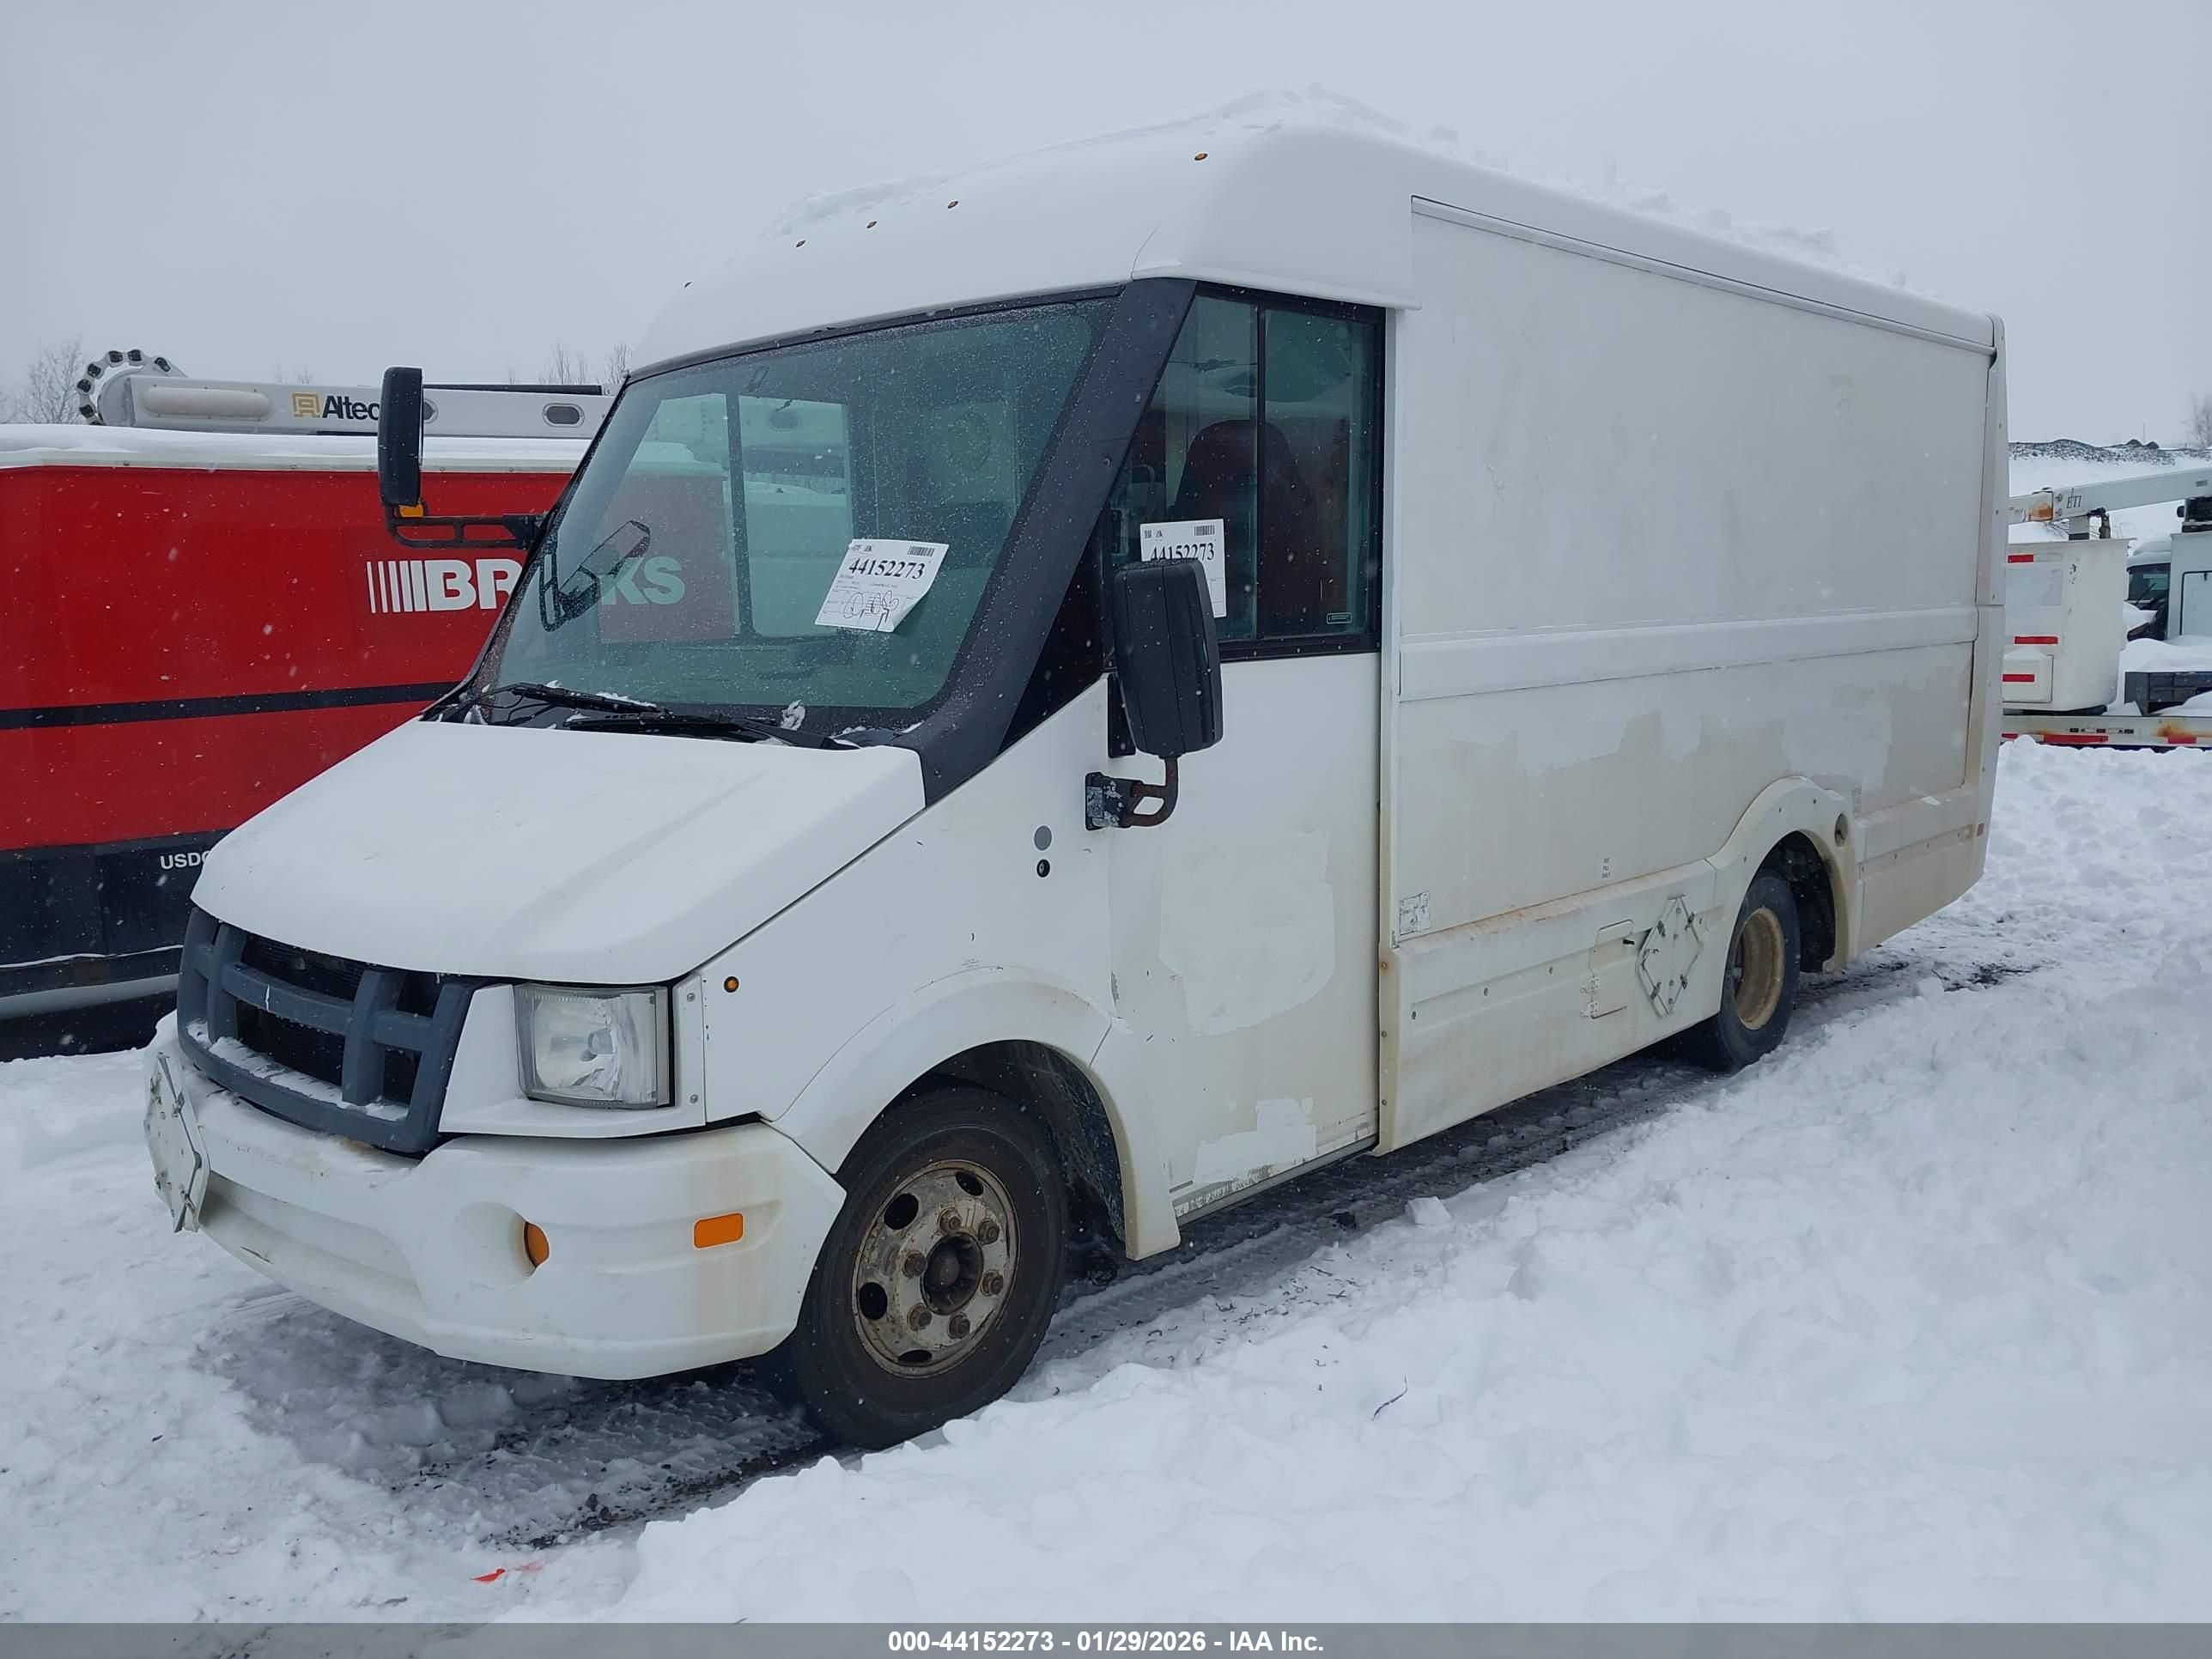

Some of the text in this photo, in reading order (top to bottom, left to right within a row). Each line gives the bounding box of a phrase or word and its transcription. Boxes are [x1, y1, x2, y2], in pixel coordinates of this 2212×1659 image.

[322, 395, 380, 421] Altec
[848, 557, 926, 580] 44152273
[425, 558, 686, 611] BRKS
